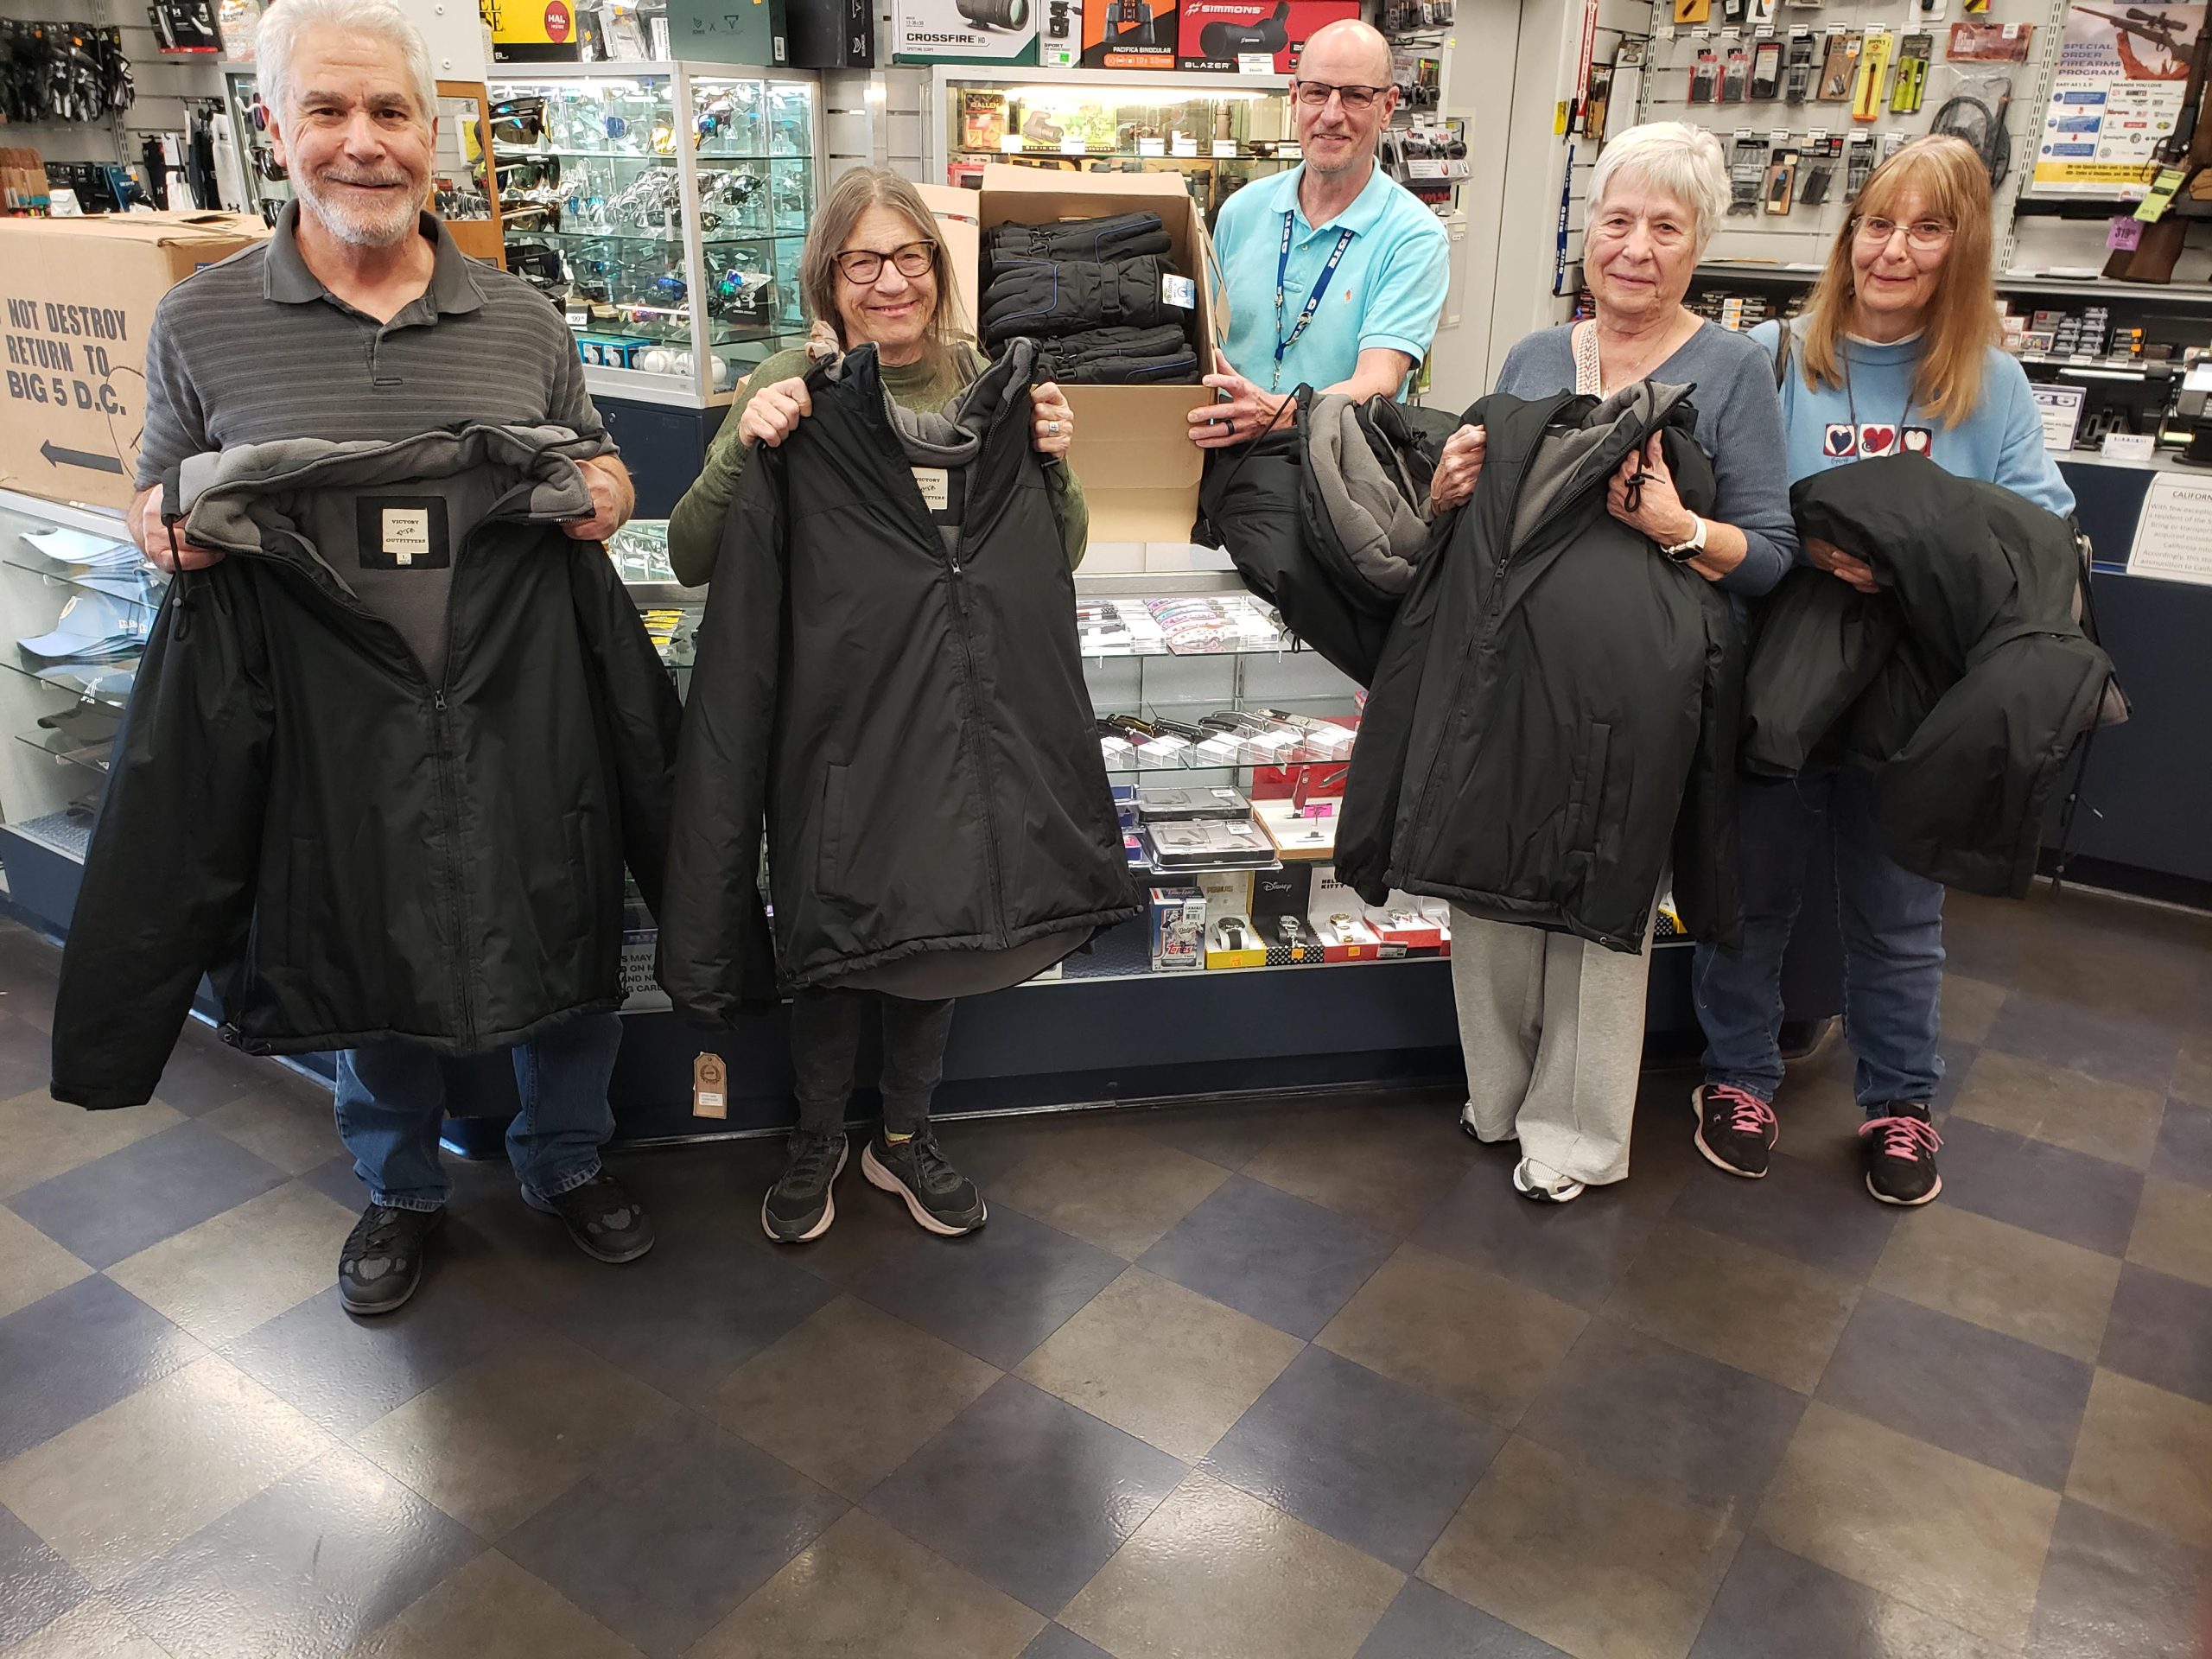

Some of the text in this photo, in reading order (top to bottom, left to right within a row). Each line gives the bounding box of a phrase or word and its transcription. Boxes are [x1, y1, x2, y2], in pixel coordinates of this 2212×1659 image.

[1202, 5, 1262, 15] SIMMONS
[906, 33, 976, 43] CROSSFIRE
[7, 298, 127, 341] NOT DESTROY
[6, 334, 110, 378] RETURN TO
[6, 370, 127, 416] BIG 5 D.C.
[2163, 541, 2196, 550] California
